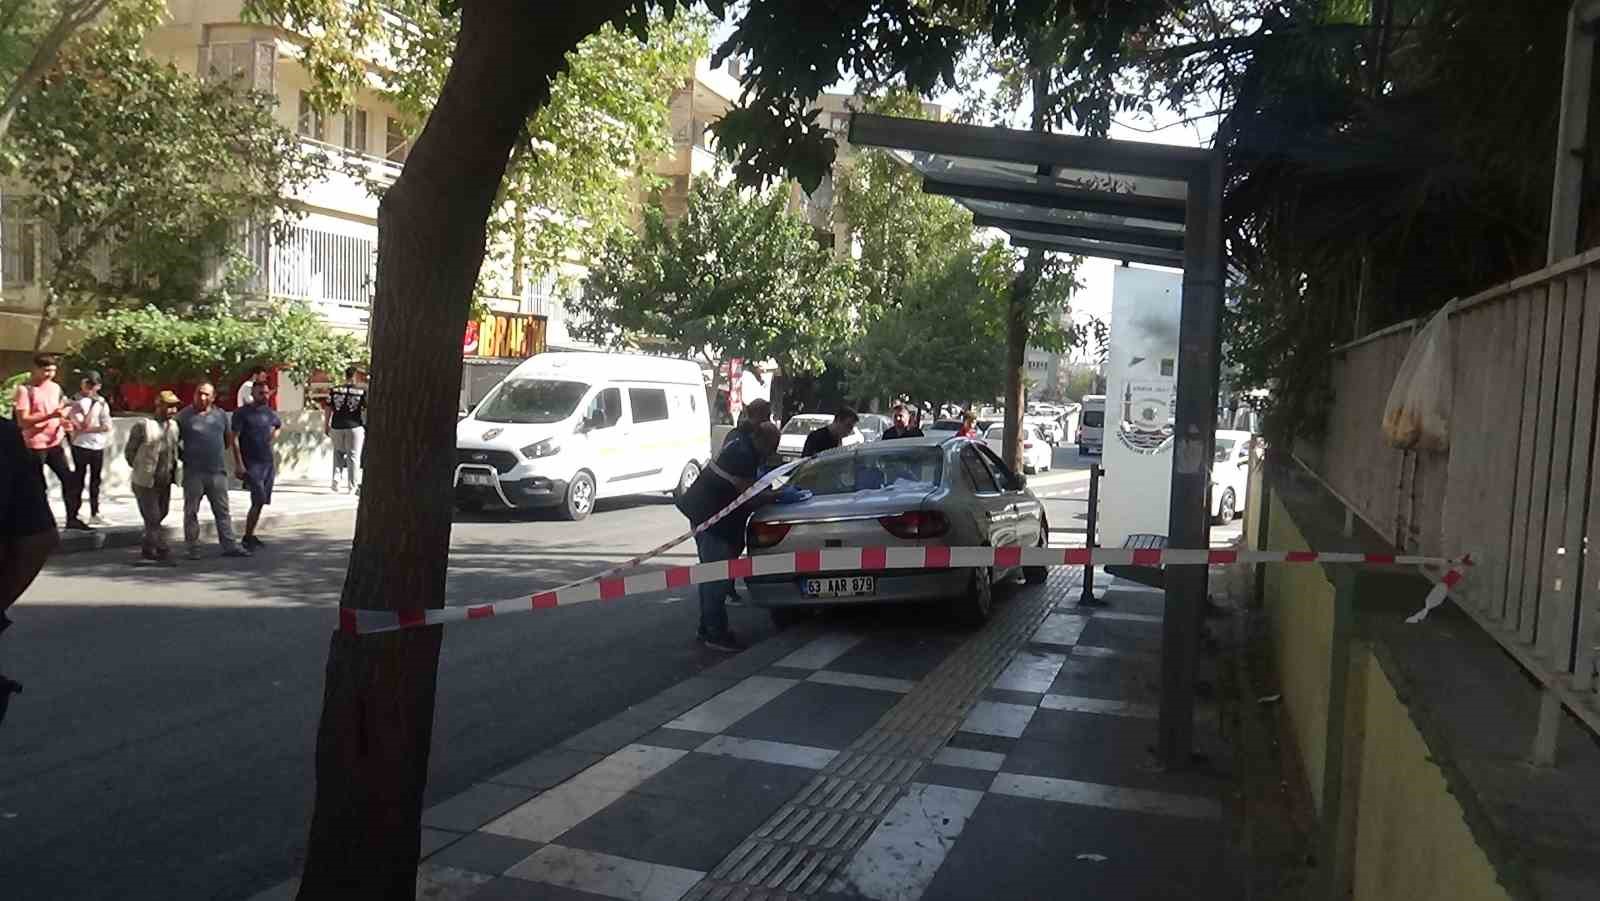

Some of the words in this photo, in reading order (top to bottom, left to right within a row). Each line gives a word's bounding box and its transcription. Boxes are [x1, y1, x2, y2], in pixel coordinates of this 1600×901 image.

[808, 580, 821, 593] 63
[828, 579, 847, 593] AAR
[852, 578, 873, 591] 879
